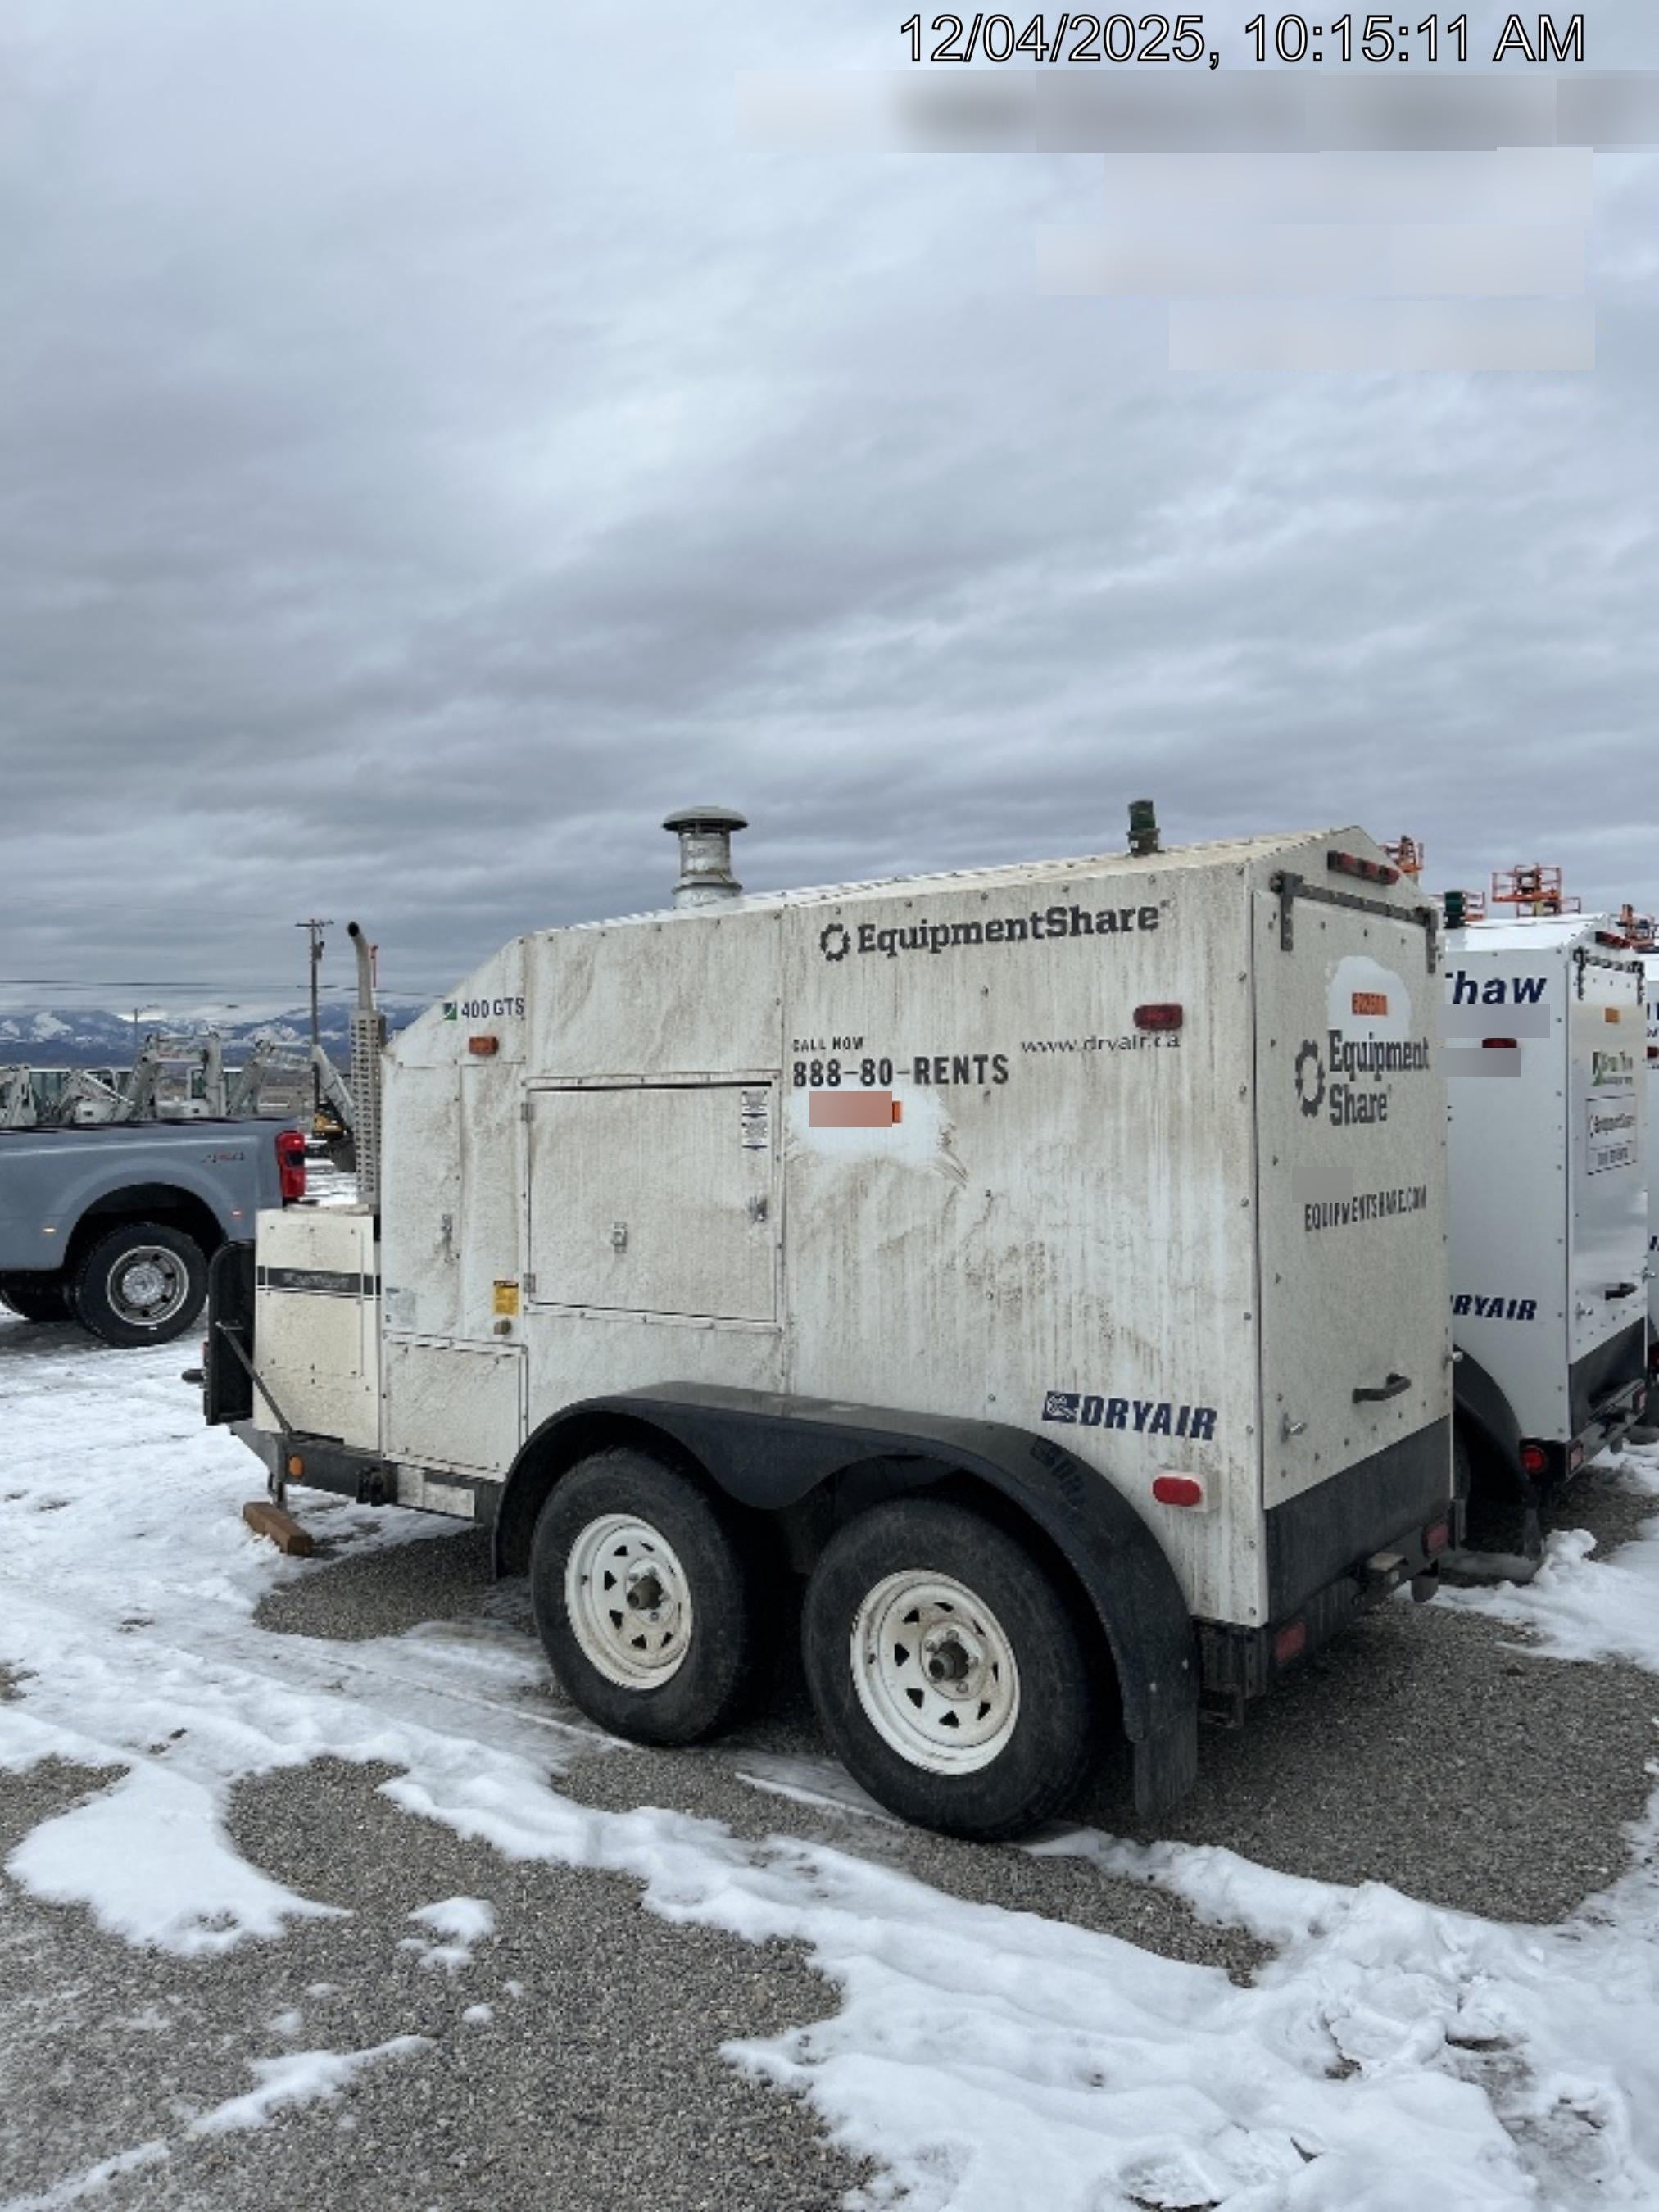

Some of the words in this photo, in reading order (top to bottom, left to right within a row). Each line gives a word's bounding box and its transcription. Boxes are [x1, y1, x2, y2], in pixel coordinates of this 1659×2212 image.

[858, 905, 1159, 958] EquipmentShare
[1445, 970, 1547, 1004] haw
[461, 999, 490, 1018] 400
[493, 997, 524, 1016] GTS
[793, 1039, 826, 1052] CALL
[832, 1036, 863, 1050] NOW
[1328, 1029, 1430, 1081] Equipment
[793, 1054, 1009, 1087] 888-80-RENTS
[1330, 1084, 1388, 1126] Share
[1450, 1294, 1537, 1321] RYAIR
[1079, 1395, 1217, 1440] DRYAIR
